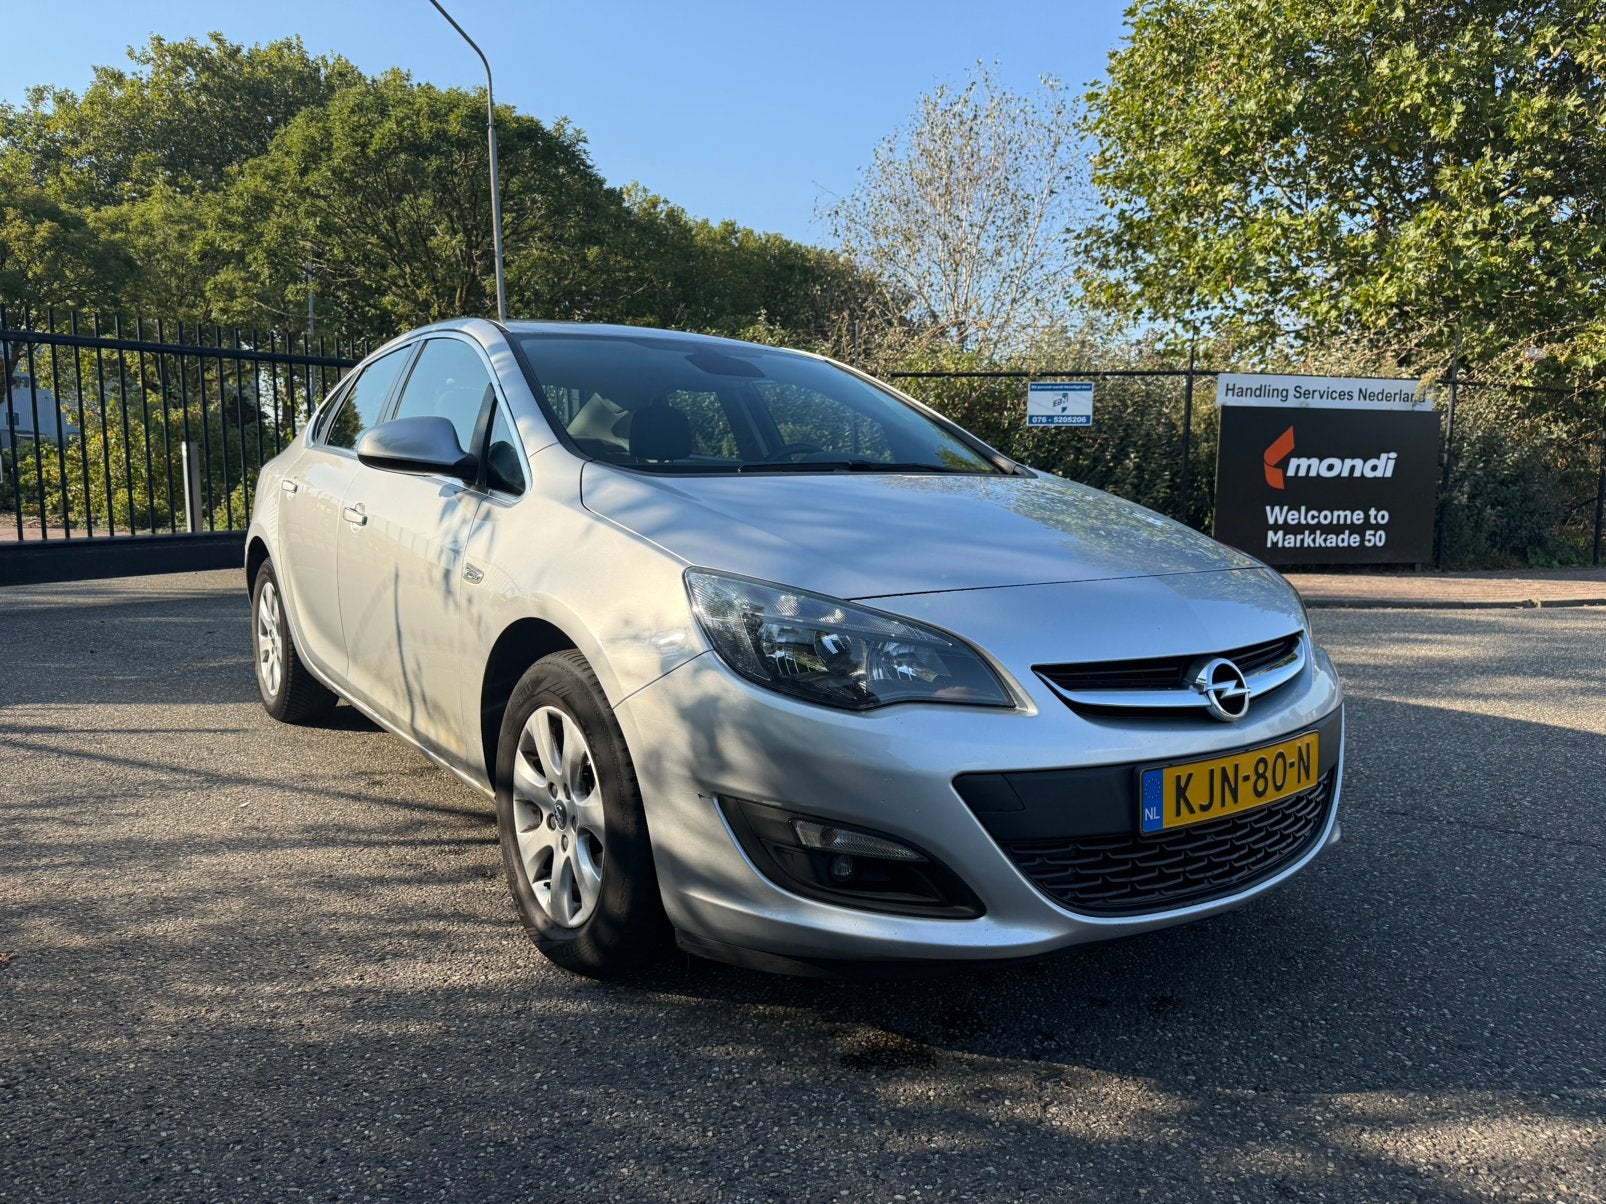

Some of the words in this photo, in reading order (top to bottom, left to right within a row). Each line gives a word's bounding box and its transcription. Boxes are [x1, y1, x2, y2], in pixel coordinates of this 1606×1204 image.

[1224, 383, 1289, 402] Handling
[1293, 385, 1354, 401] Services
[1286, 452, 1398, 478] mondi
[1265, 505, 1364, 525] Welcome
[1369, 507, 1389, 525] to
[1266, 530, 1361, 548] Markkade
[1364, 530, 1386, 547] 50
[1175, 742, 1311, 818] KJN-80-N
[1144, 806, 1161, 821] NL
